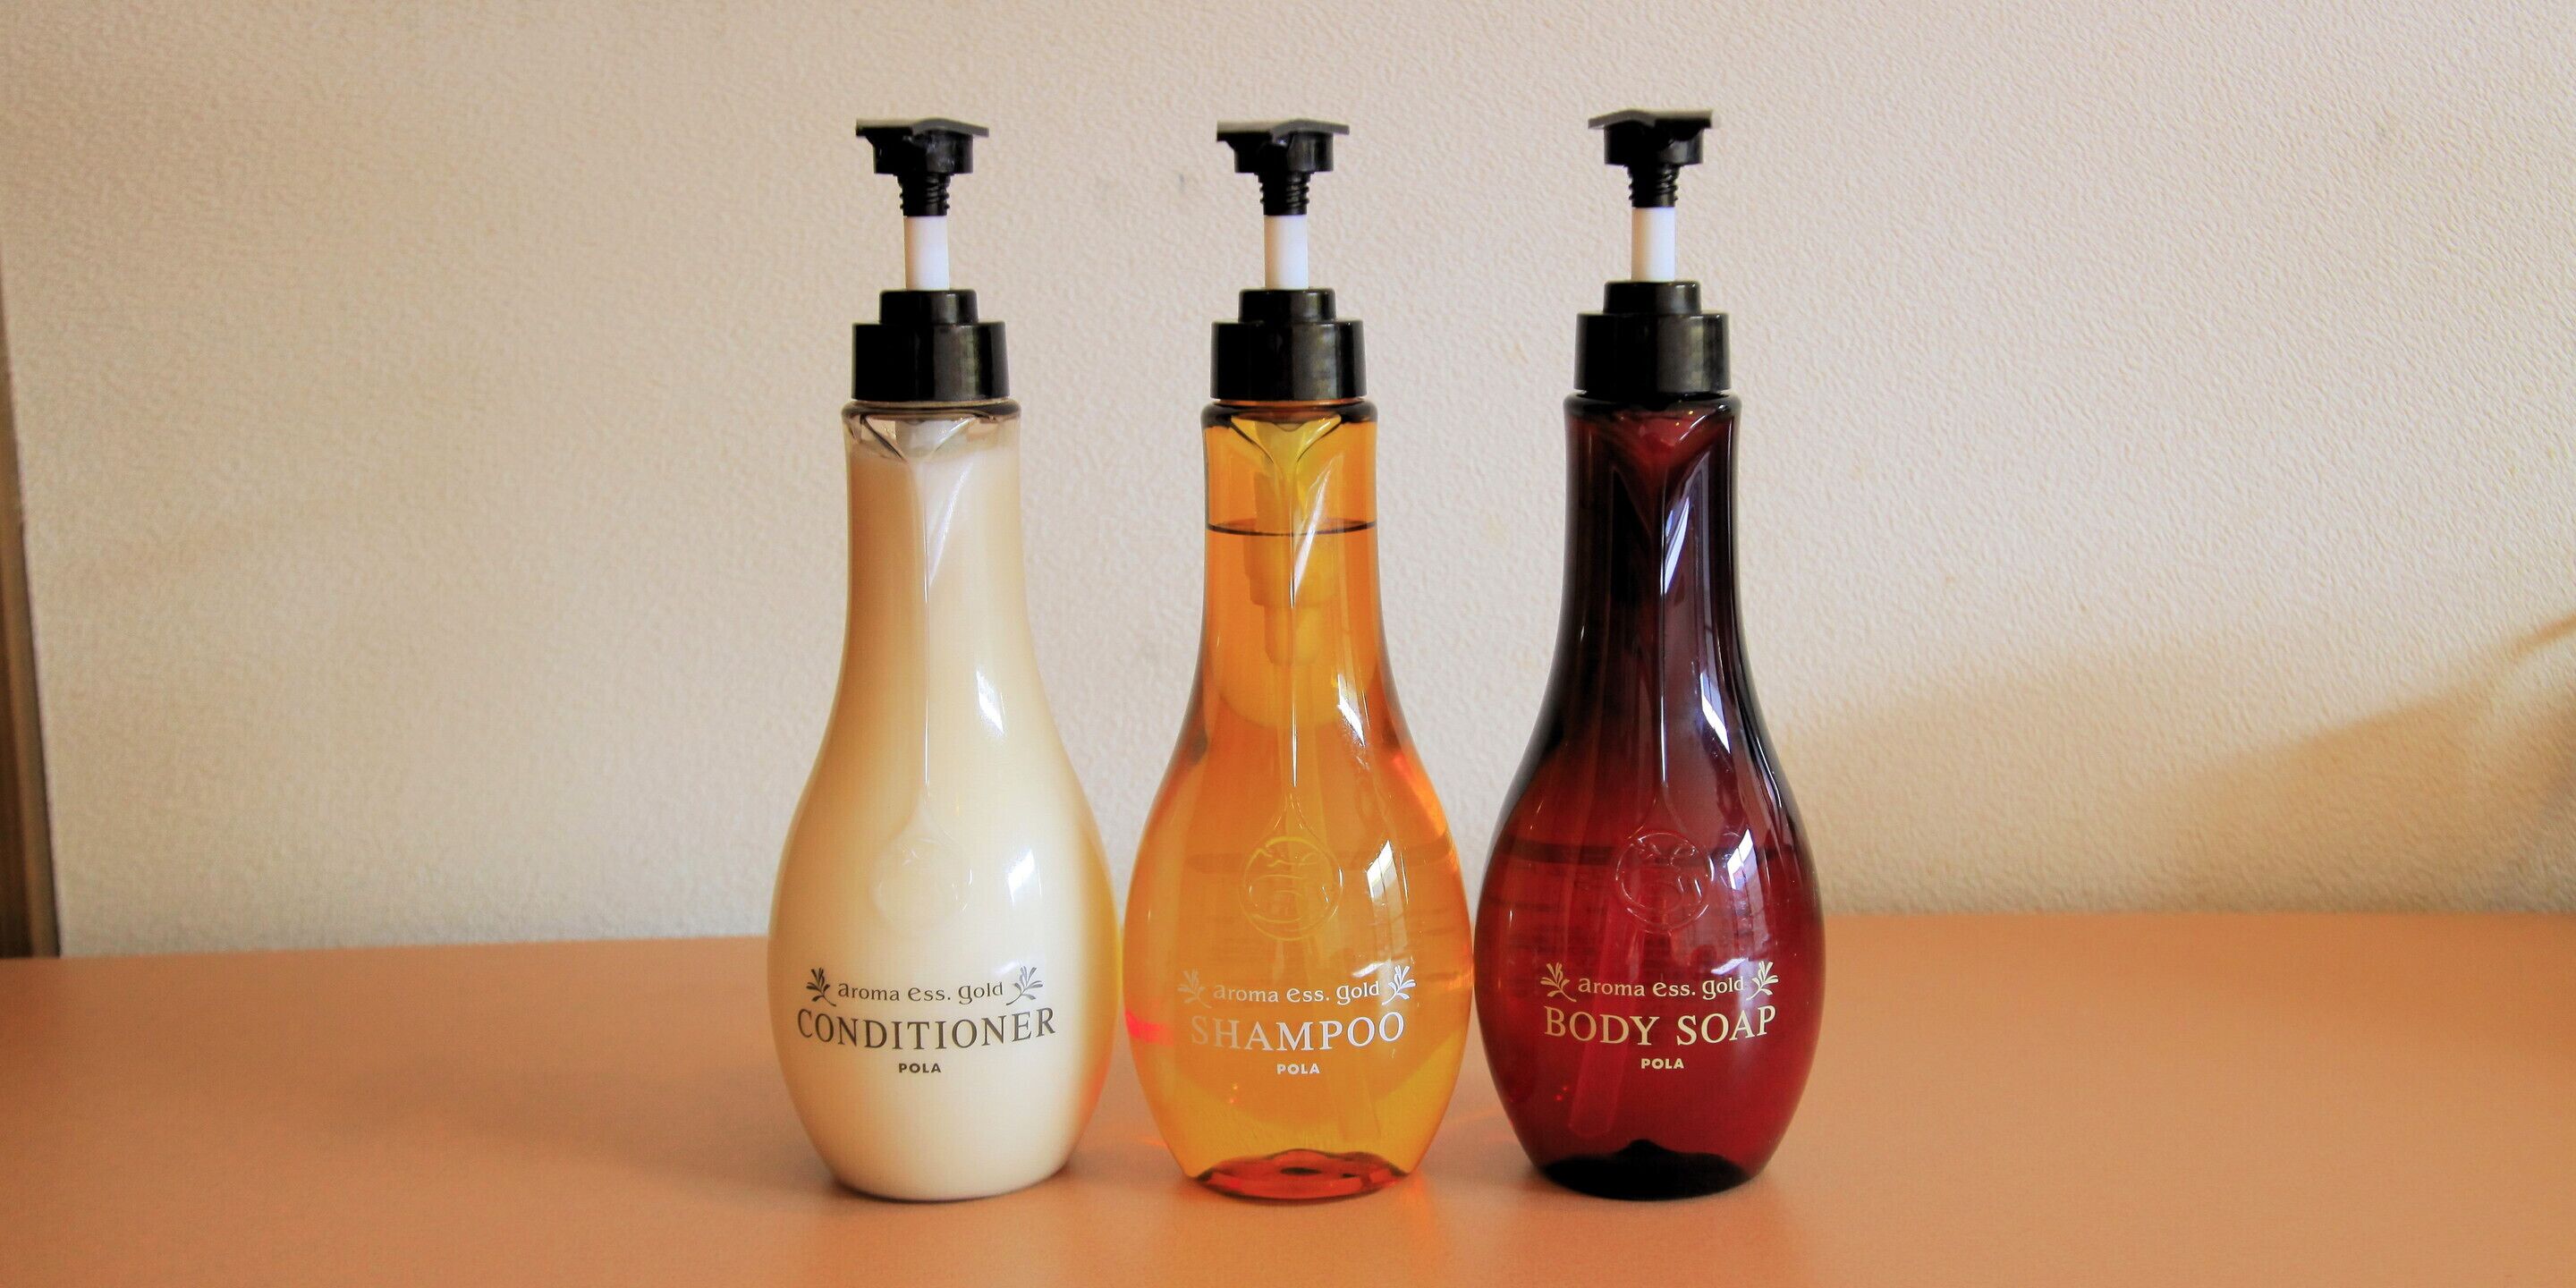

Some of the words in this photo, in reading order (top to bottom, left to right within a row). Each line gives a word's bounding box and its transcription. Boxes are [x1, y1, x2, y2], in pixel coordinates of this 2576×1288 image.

[838, 983, 900, 1002] aroma
[908, 987, 952, 1002] ess.
[958, 981, 1004, 1004] gold
[1213, 984, 1279, 1003] aroma
[1286, 987, 1330, 1003] ess.
[1335, 980, 1380, 1005] gold
[1578, 978, 1646, 997] aroma
[1652, 982, 1696, 997] ess.
[1702, 976, 1745, 1000] gold
[797, 1007, 1055, 1050] CONDITIONER
[1191, 1012, 1405, 1051] SHAMPOO
[1544, 1005, 1660, 1046] BODY
[1676, 1004, 1776, 1046] SOAP
[898, 1062, 942, 1073] POLA
[1276, 1063, 1320, 1075] POLA
[1640, 1058, 1684, 1070] POLA
